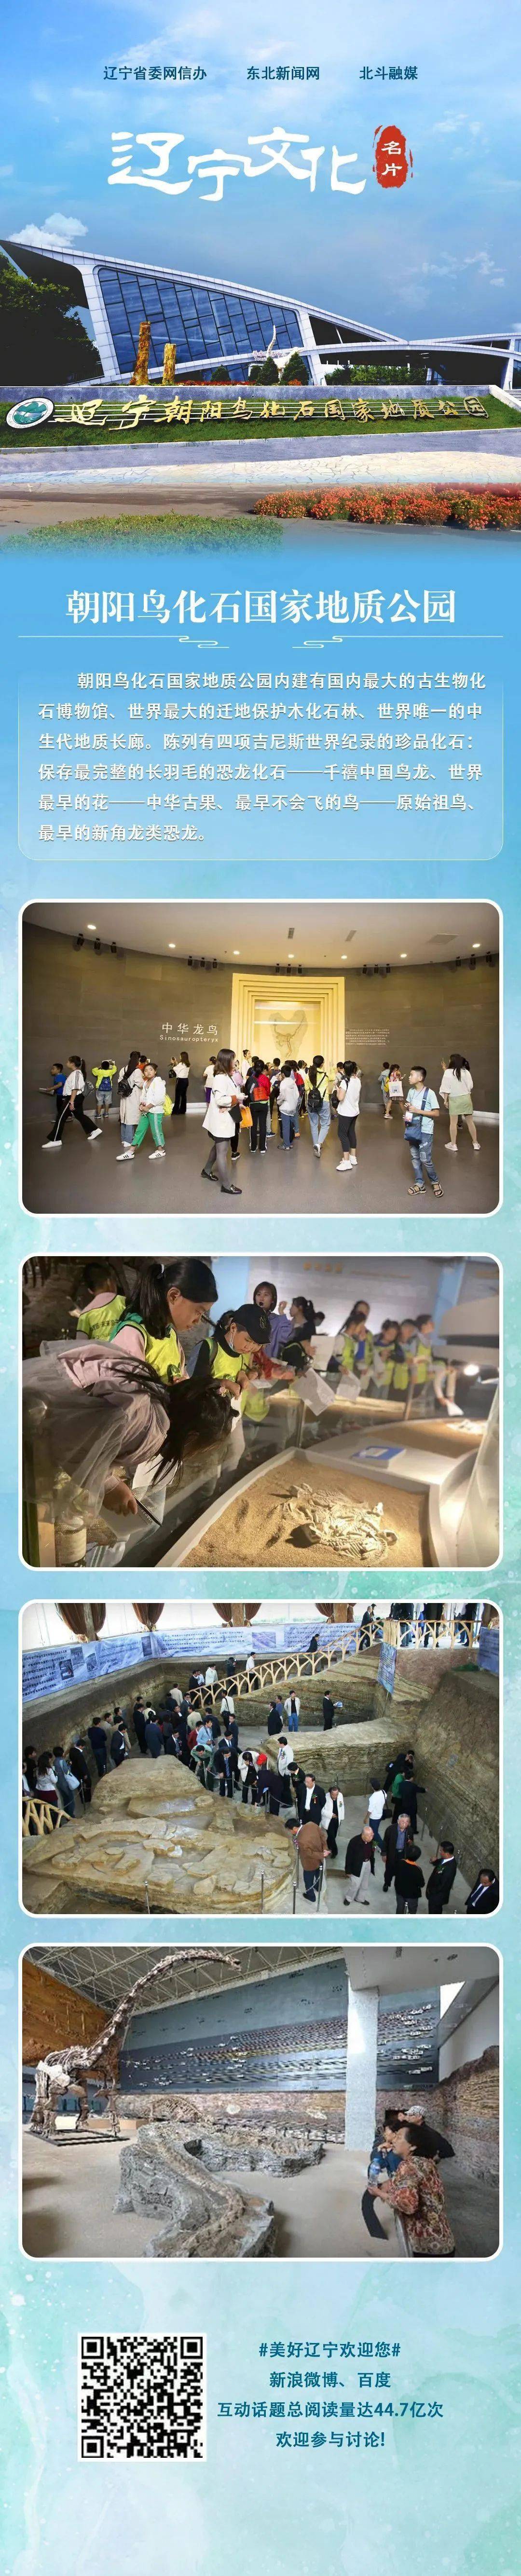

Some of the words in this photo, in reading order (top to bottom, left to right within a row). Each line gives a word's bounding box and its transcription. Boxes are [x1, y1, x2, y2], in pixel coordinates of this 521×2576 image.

[54, 394, 489, 430] 辽宁朝阳鸟化石国家地质公园
[162, 1022, 218, 1035] 中华龙鸟
[159, 1034, 219, 1043] Sinosauropteryx
